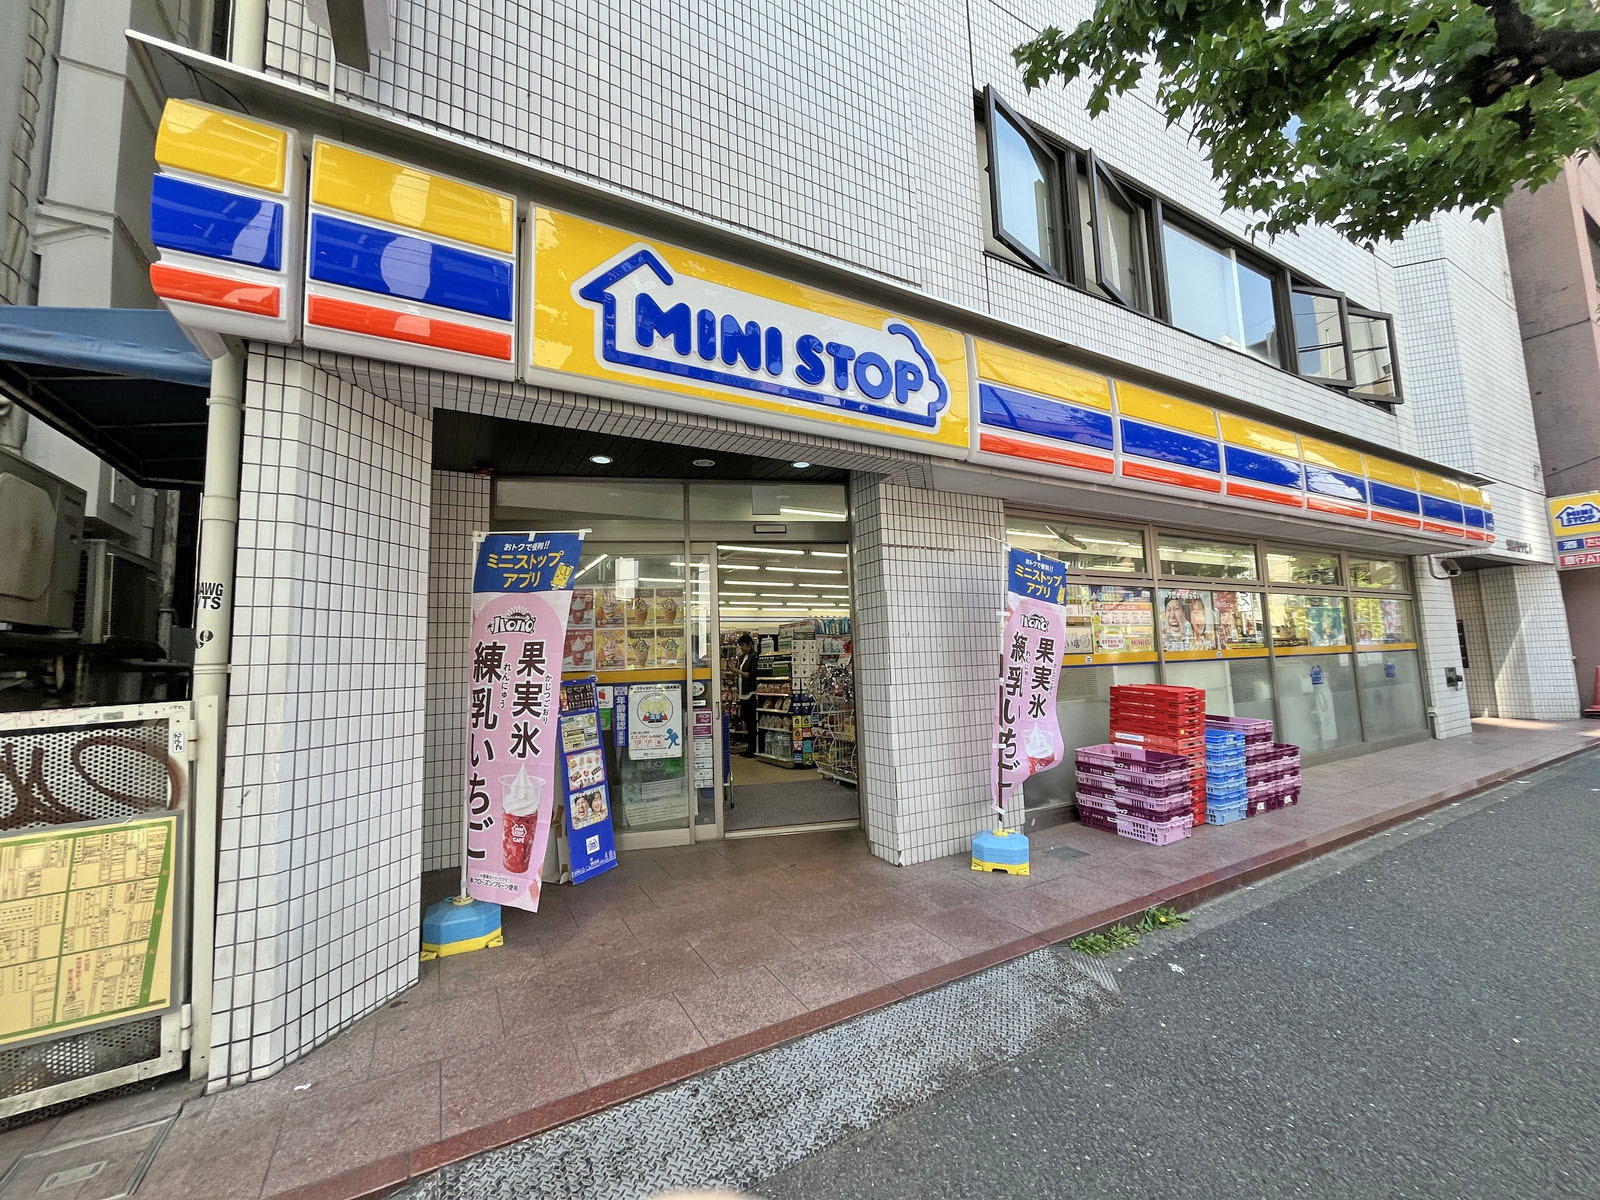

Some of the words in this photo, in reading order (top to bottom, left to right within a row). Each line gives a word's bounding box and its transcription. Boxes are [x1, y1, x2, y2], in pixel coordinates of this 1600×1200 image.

[635, 292, 783, 377] MINI
[795, 334, 924, 404] STOP
[1566, 514, 1596, 524] STOP
[486, 550, 565, 570] ミニストップ
[502, 571, 542, 589] アプリ
[1014, 563, 1063, 587] ミニストップ
[1026, 582, 1051, 599] アプリ
[1027, 637, 1055, 719] 果実氷
[509, 641, 547, 759] 果実氷
[467, 640, 507, 859] 練乳いちご
